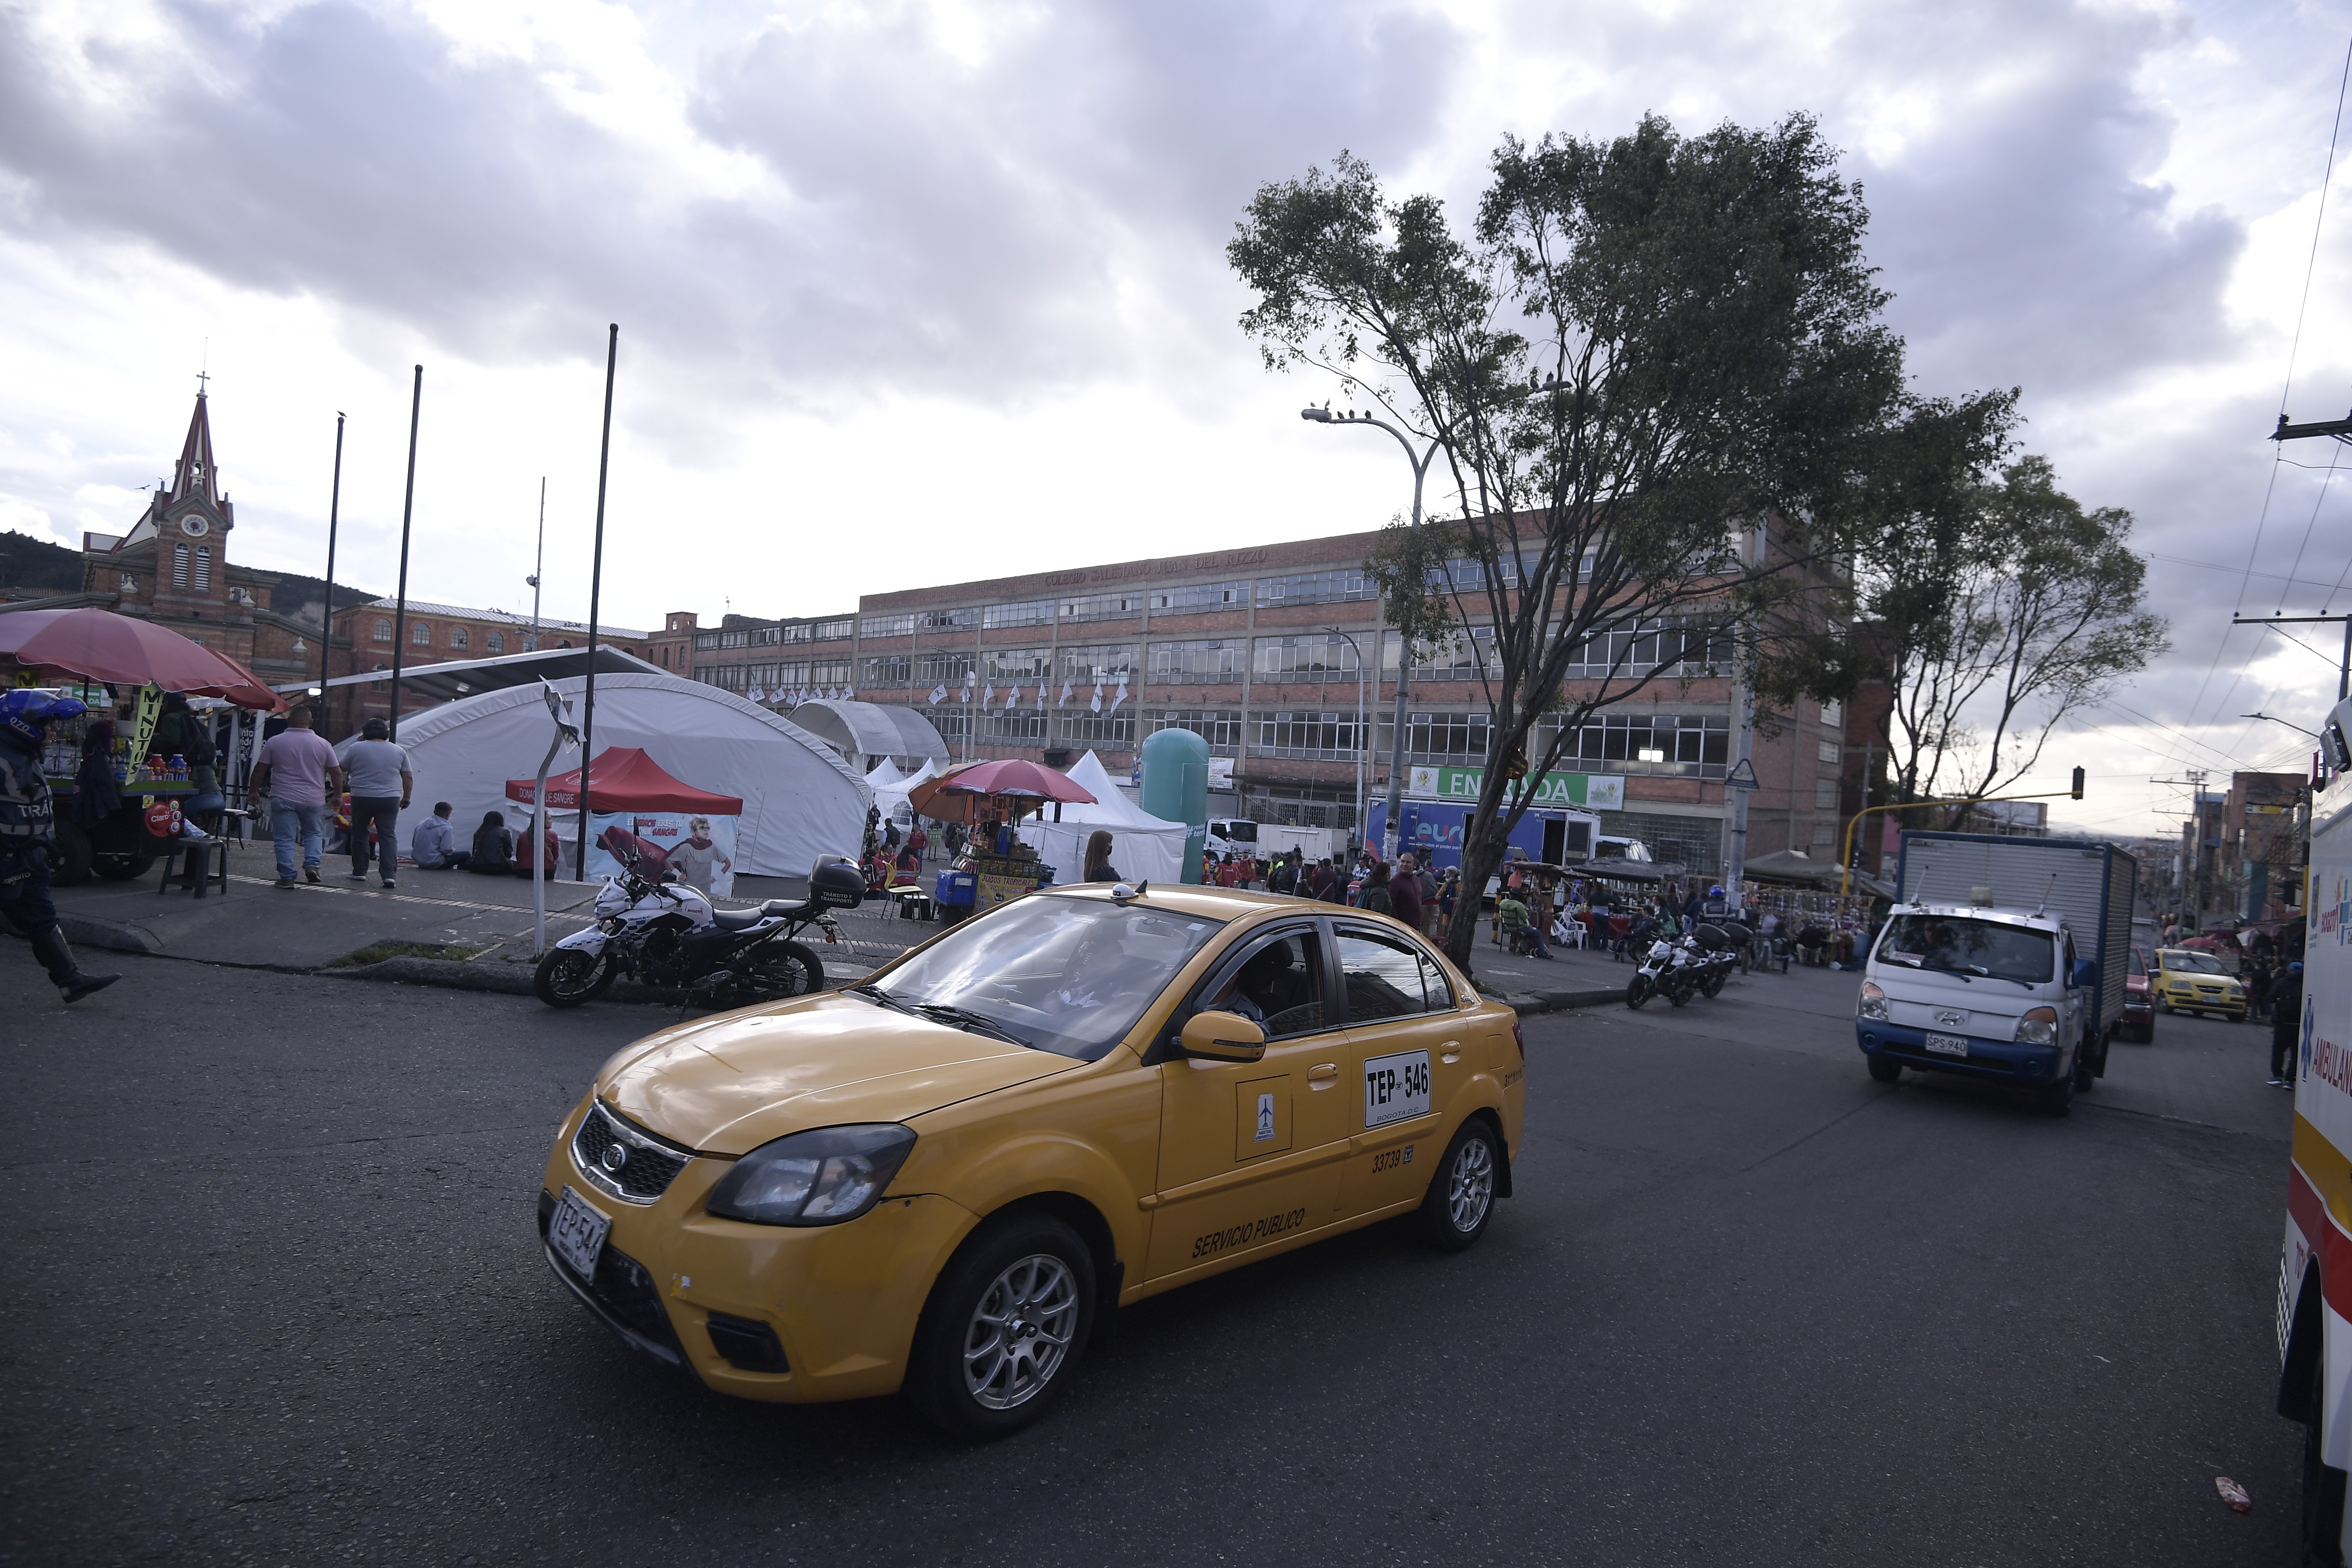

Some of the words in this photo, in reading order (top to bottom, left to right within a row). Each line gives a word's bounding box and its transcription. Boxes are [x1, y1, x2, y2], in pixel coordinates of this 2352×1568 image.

[10, 716, 30, 732] 070
[130, 690, 161, 775] MINUTOS
[1451, 773, 1570, 802] ENRADA
[520, 788, 536, 800] DONAC
[546, 792, 553, 802] DE
[554, 792, 574, 804] SANGRE
[151, 811, 171, 822] Claro
[982, 875, 1001, 884] JUGOS
[1003, 878, 1034, 886] TROPICALES
[820, 896, 853, 904] TRANSPORTE
[1927, 1037, 1945, 1048] SPS
[1948, 1040, 1965, 1051] 940
[1367, 1069, 1395, 1106] TEP
[1405, 1062, 1428, 1098] 546
[1377, 1111, 1406, 1122] BOGOTA
[1372, 1149, 1401, 1173] 33739
[1192, 1222, 1253, 1258] SERVICIO
[1253, 1207, 1305, 1240] PUBLICO
